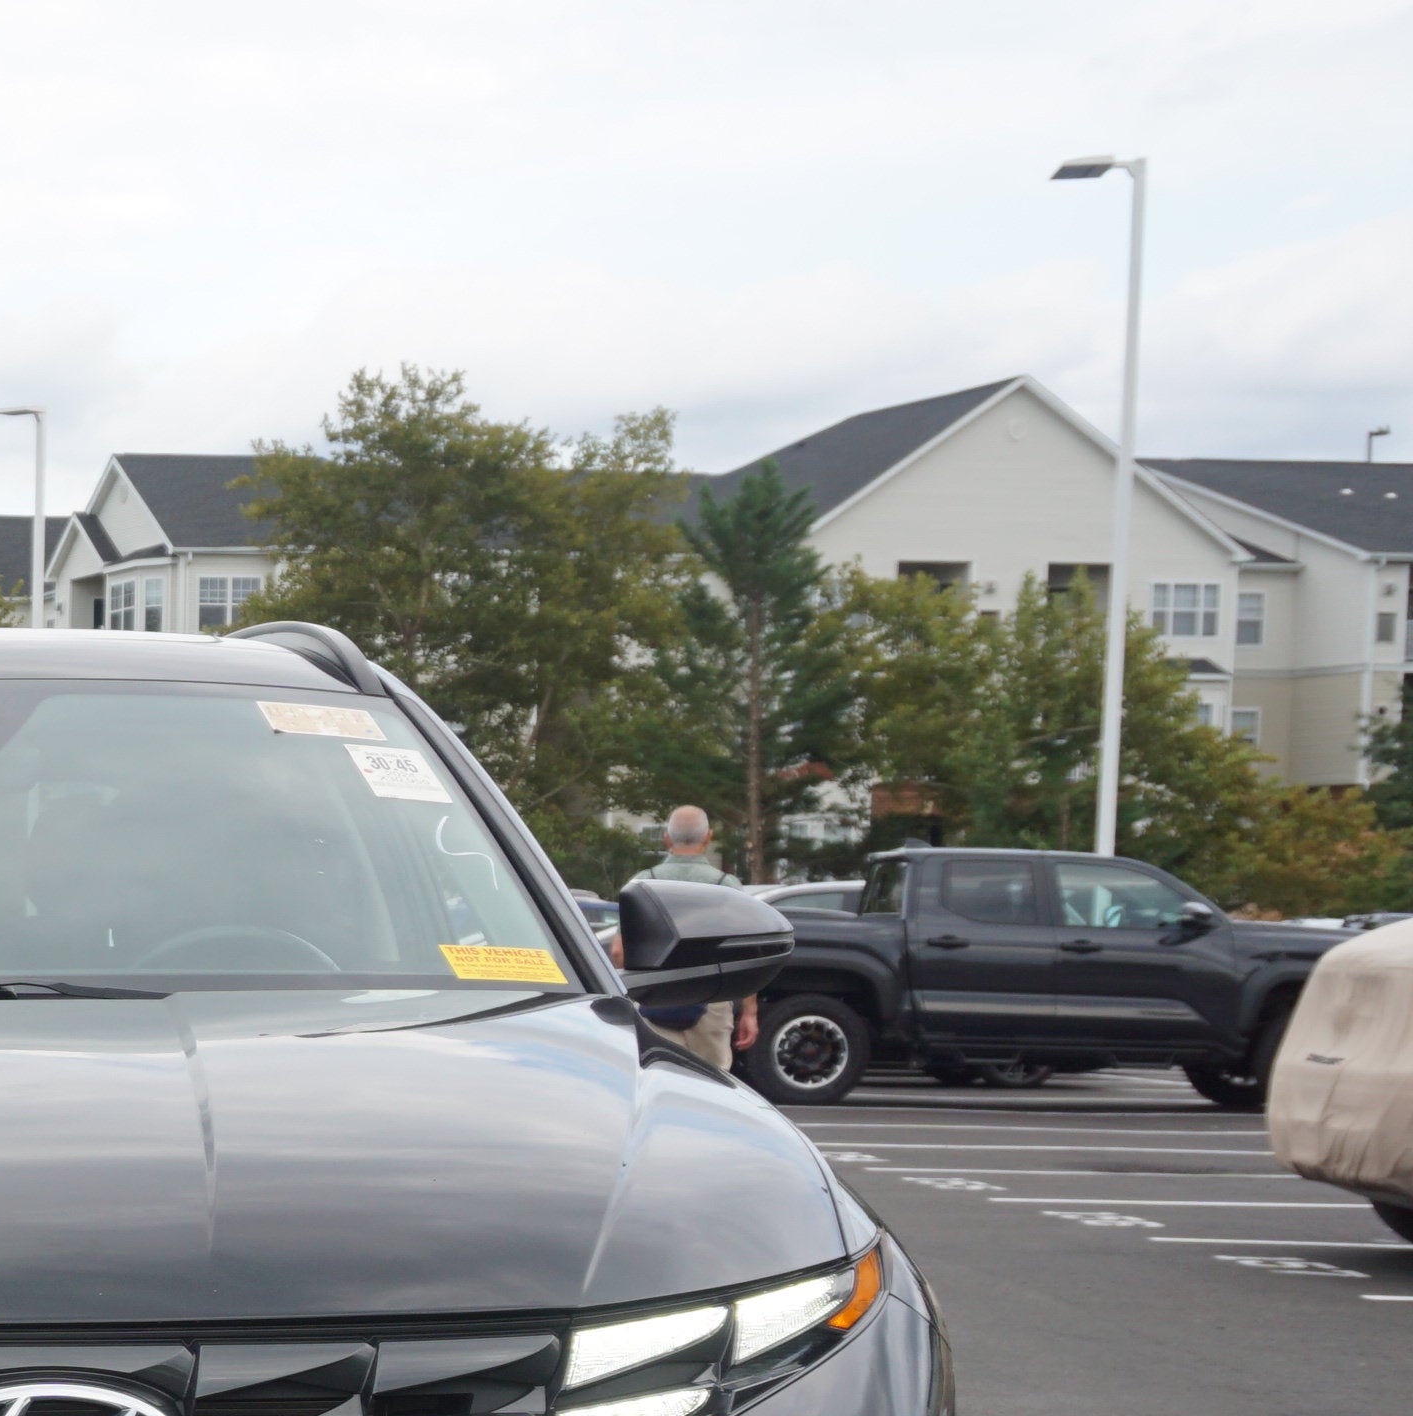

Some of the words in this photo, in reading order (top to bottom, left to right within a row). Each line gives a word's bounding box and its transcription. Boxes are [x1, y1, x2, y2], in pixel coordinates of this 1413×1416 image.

[444, 946, 480, 956] THIS
[483, 948, 547, 958] VEHICLE
[454, 955, 481, 964] NOT
[484, 956, 512, 965] FOR
[515, 957, 549, 966] SALE
[1214, 1254, 1373, 1280] 157
